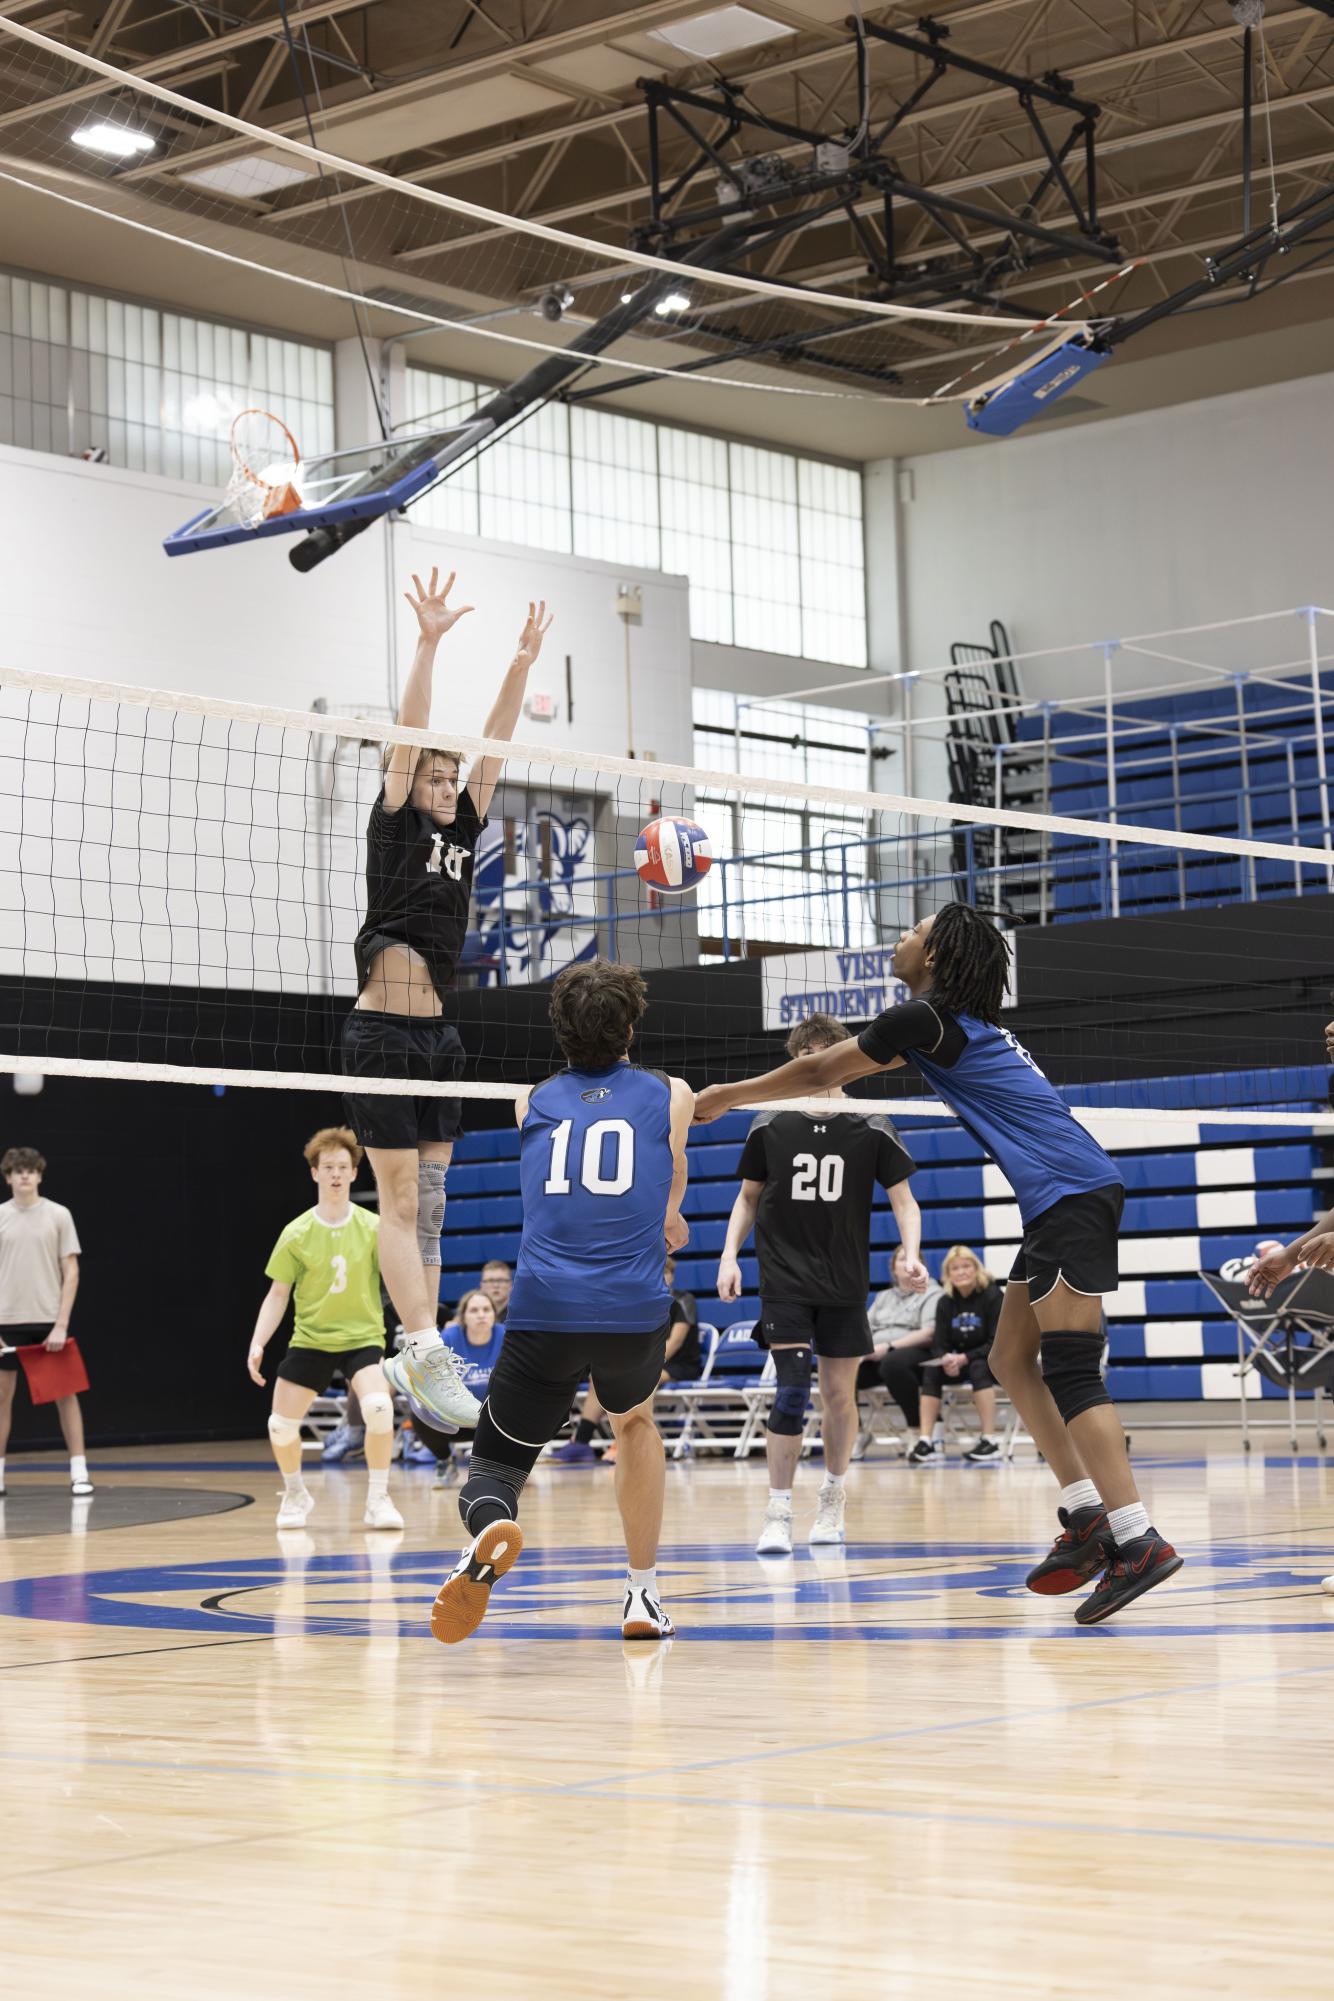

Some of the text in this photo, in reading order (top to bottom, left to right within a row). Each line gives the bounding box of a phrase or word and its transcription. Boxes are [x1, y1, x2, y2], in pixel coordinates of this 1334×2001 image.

[780, 986, 885, 1023] STUDENT
[543, 1118, 636, 1197] 10
[791, 1152, 845, 1202] 20
[329, 1254, 347, 1294] 3
